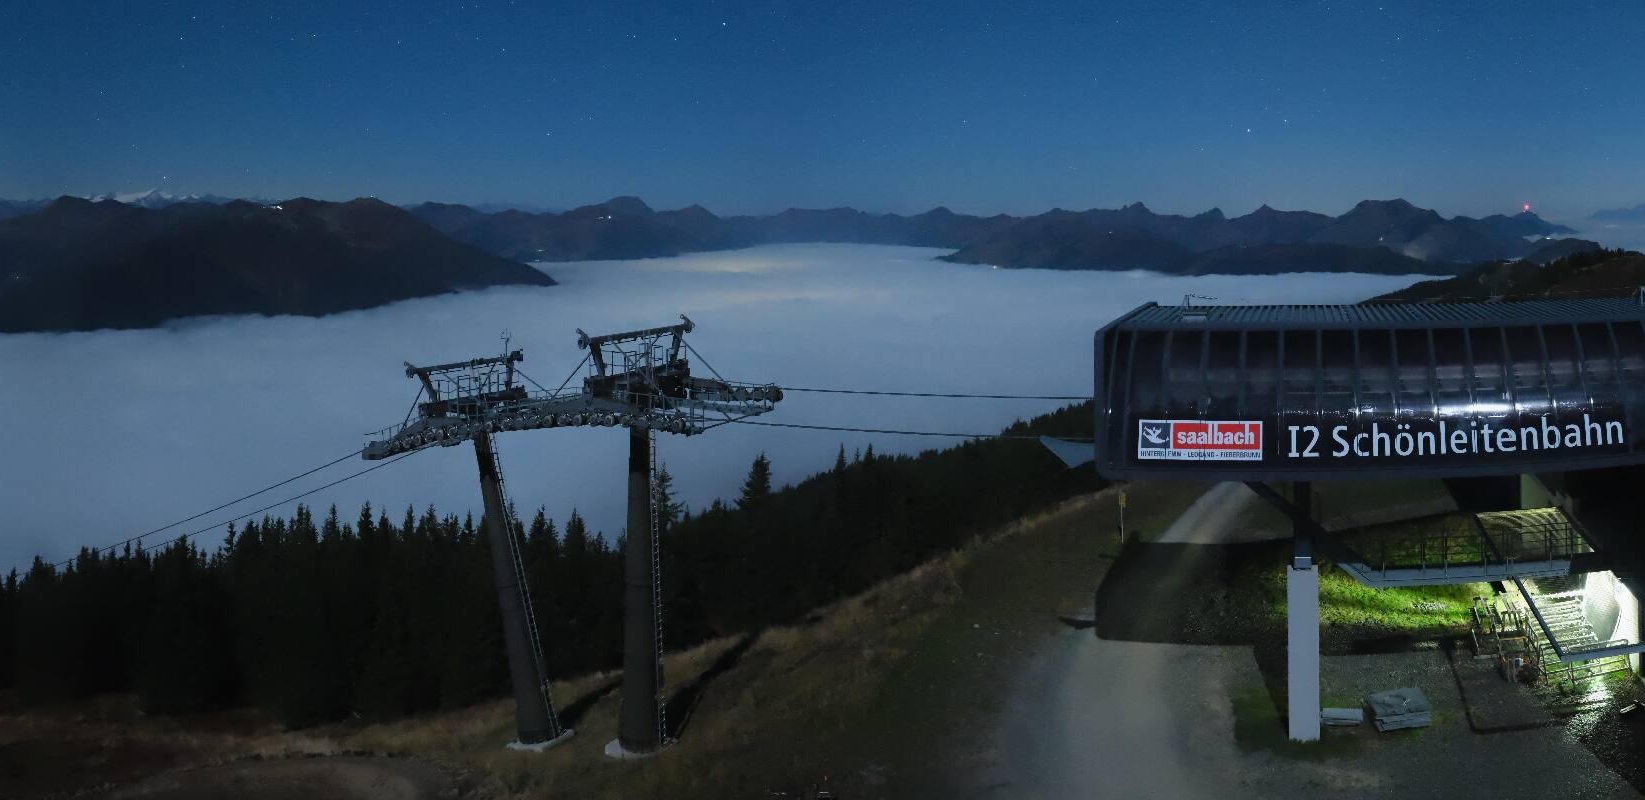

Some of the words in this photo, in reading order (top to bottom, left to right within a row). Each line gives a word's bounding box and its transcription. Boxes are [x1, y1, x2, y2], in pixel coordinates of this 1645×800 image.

[1177, 424, 1255, 445] saalbach
[1288, 425, 1320, 457] I2
[1332, 413, 1624, 457] Schönleitenbahn
